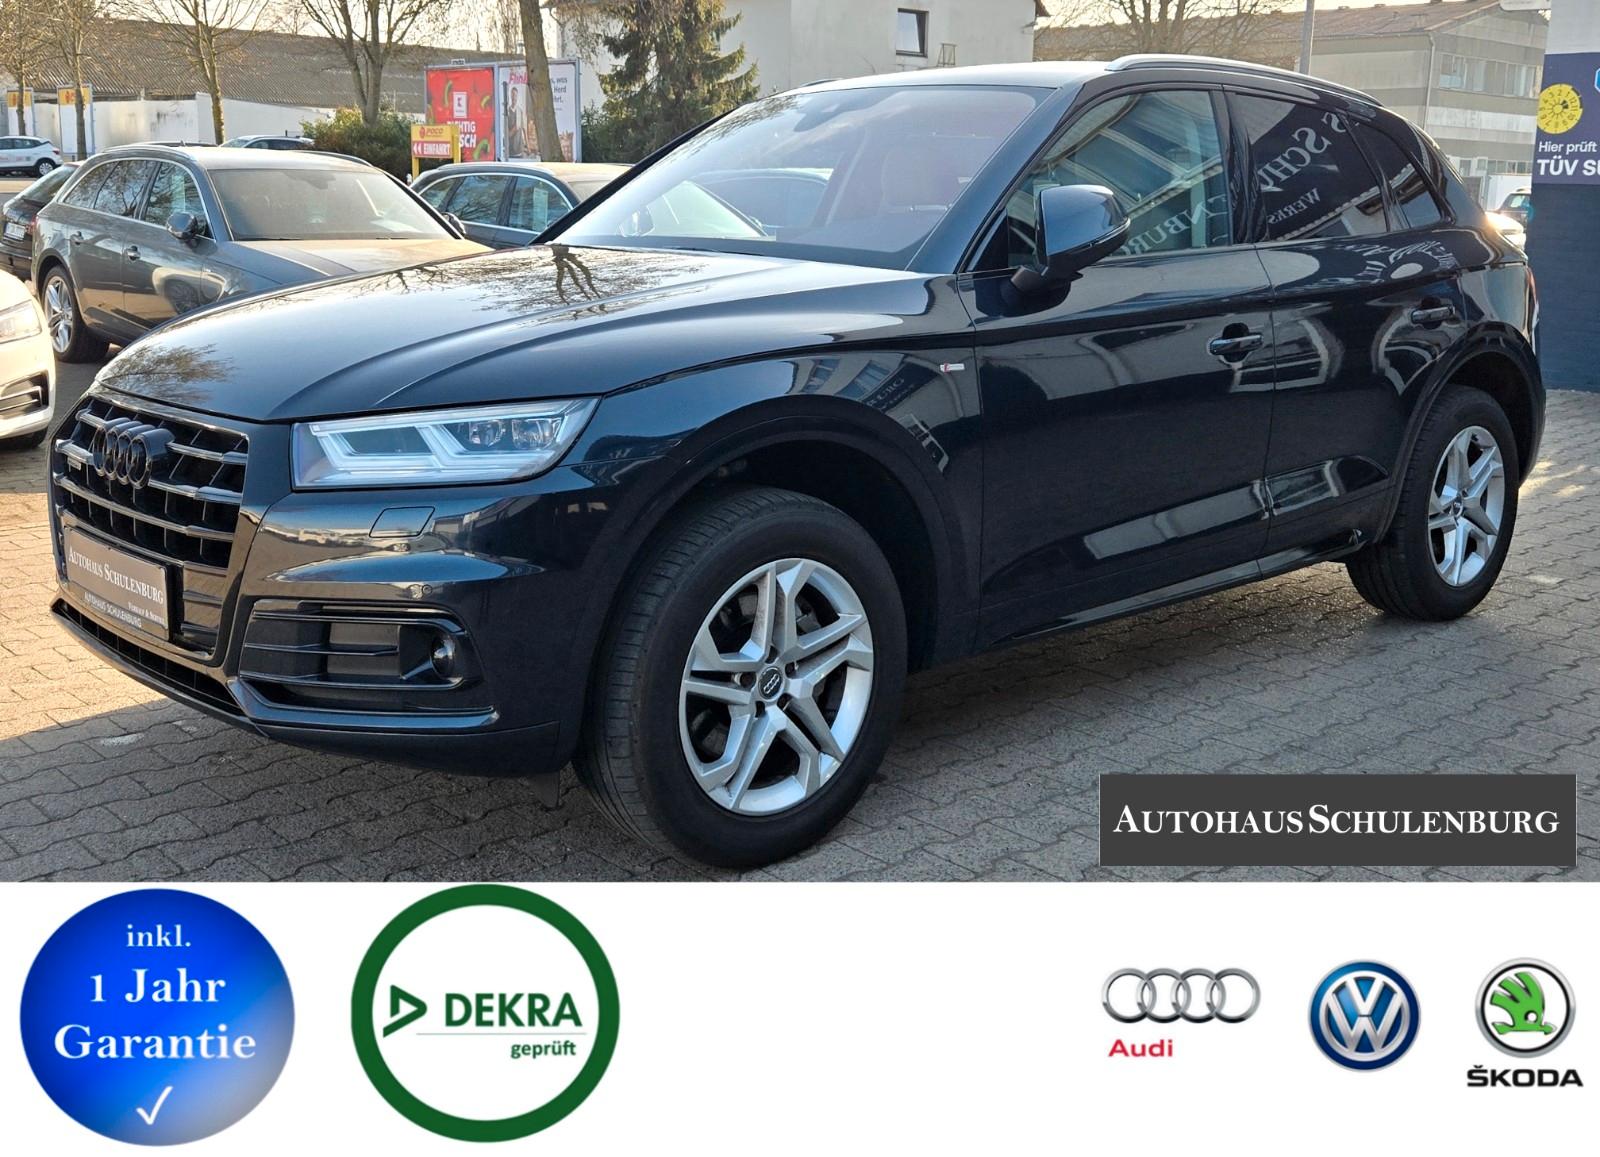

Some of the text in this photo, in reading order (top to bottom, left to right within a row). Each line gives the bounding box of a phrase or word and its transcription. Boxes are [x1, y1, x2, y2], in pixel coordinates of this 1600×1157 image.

[1538, 140, 1598, 155] Hier prüft
[1537, 155, 1578, 176] TÜV
[68, 546, 164, 604] AUTOHAUS SCHULENBURG
